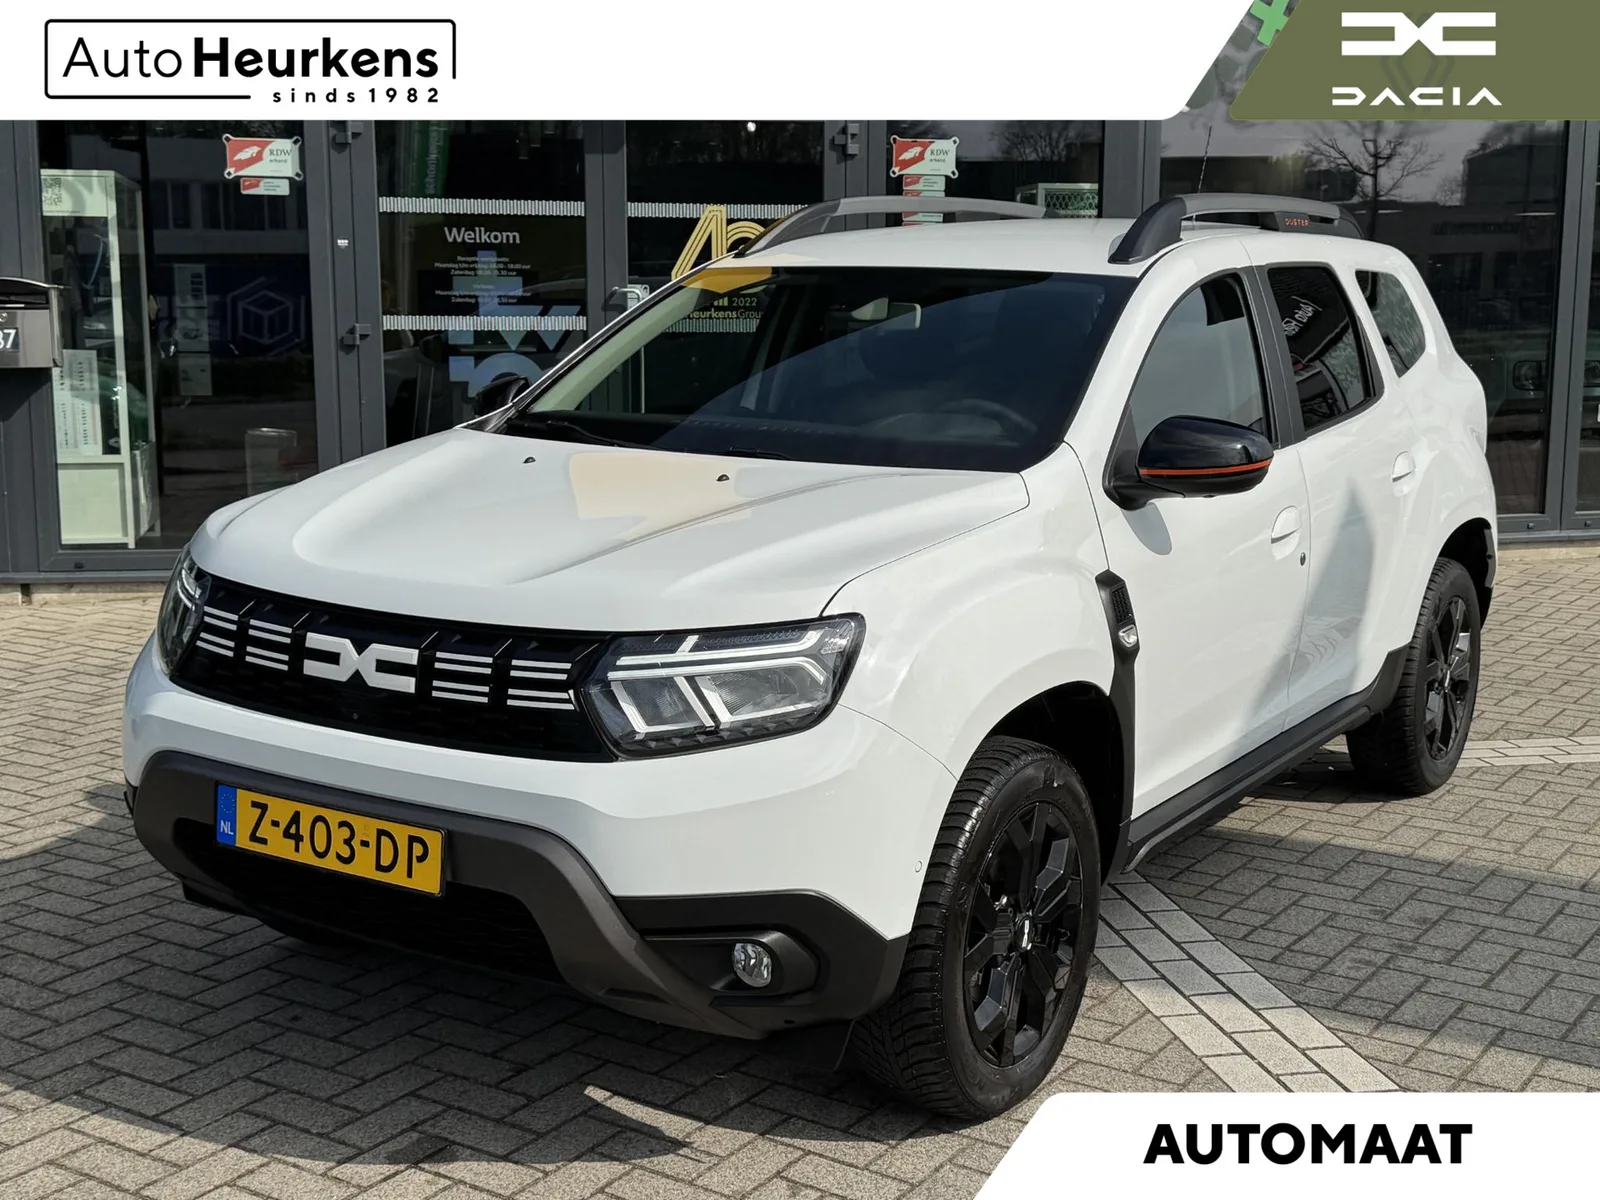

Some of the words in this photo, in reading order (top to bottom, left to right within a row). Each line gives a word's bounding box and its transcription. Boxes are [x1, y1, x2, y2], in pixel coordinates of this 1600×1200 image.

[268, 148, 292, 157] RDW
[930, 148, 950, 157] RDW
[1283, 218, 1309, 227] DUSTER
[443, 226, 521, 244] Welkom
[732, 297, 757, 306] 2022
[219, 818, 236, 837] NL
[247, 799, 431, 879] Z-403-DP
